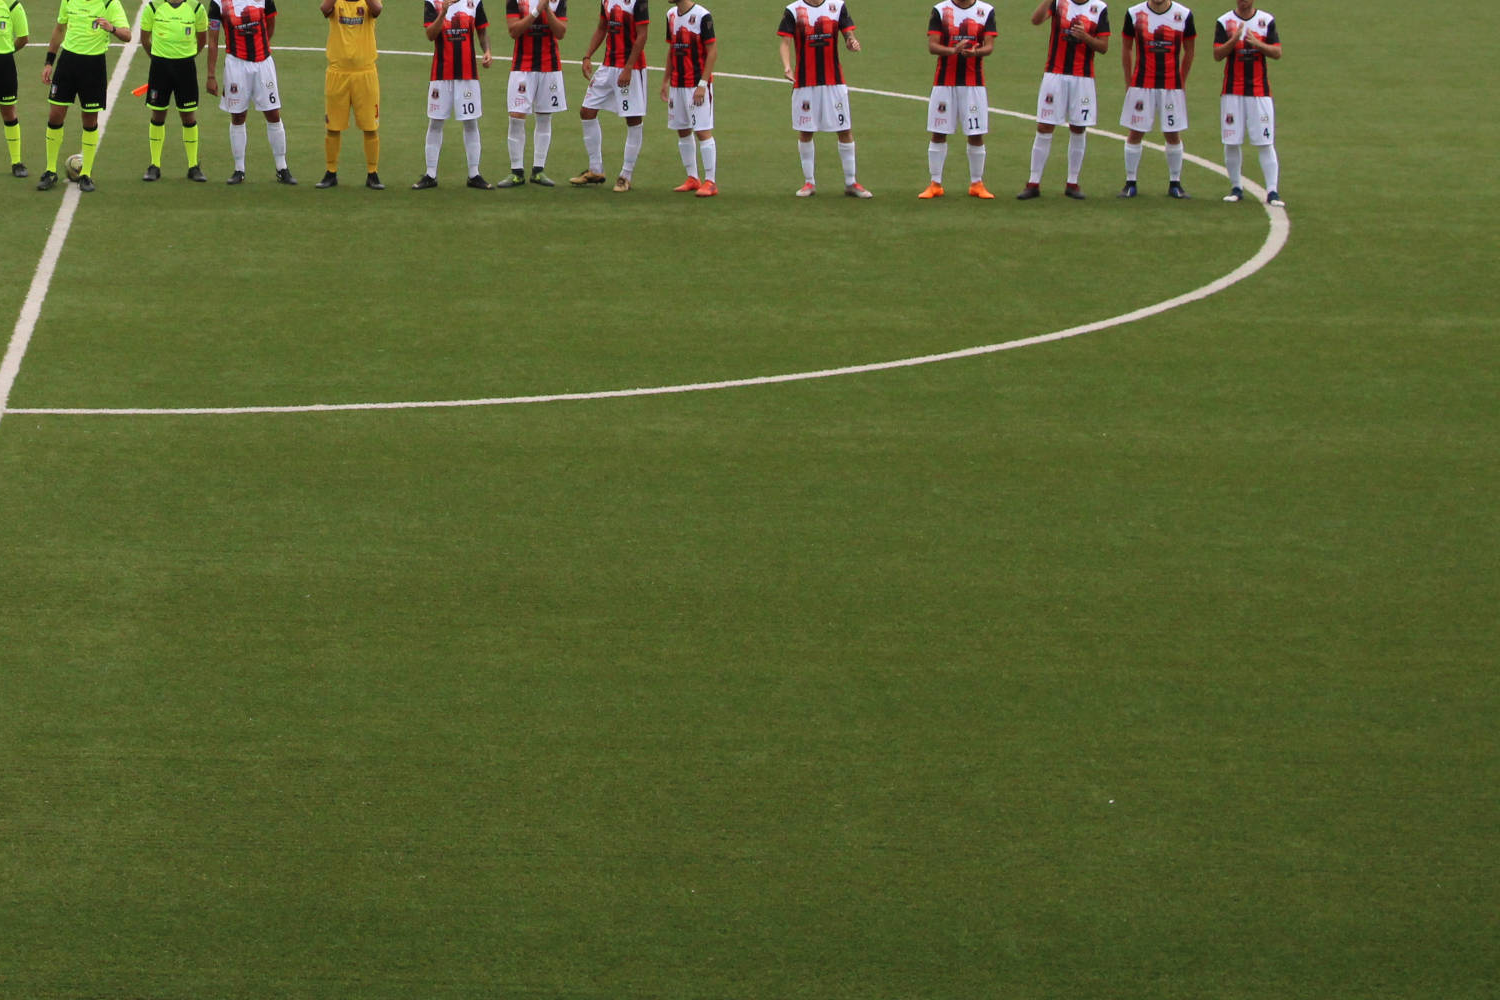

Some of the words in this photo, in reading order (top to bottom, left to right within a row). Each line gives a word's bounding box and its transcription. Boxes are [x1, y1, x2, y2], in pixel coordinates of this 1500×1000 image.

[269, 92, 276, 104] 6
[551, 96, 559, 107] 2
[462, 102, 475, 115] 10
[622, 100, 629, 111] 8
[838, 113, 845, 126] 9
[1081, 109, 1089, 121] 7
[1167, 114, 1175, 127] 5
[968, 117, 980, 130] 11
[1263, 127, 1270, 139] 4
